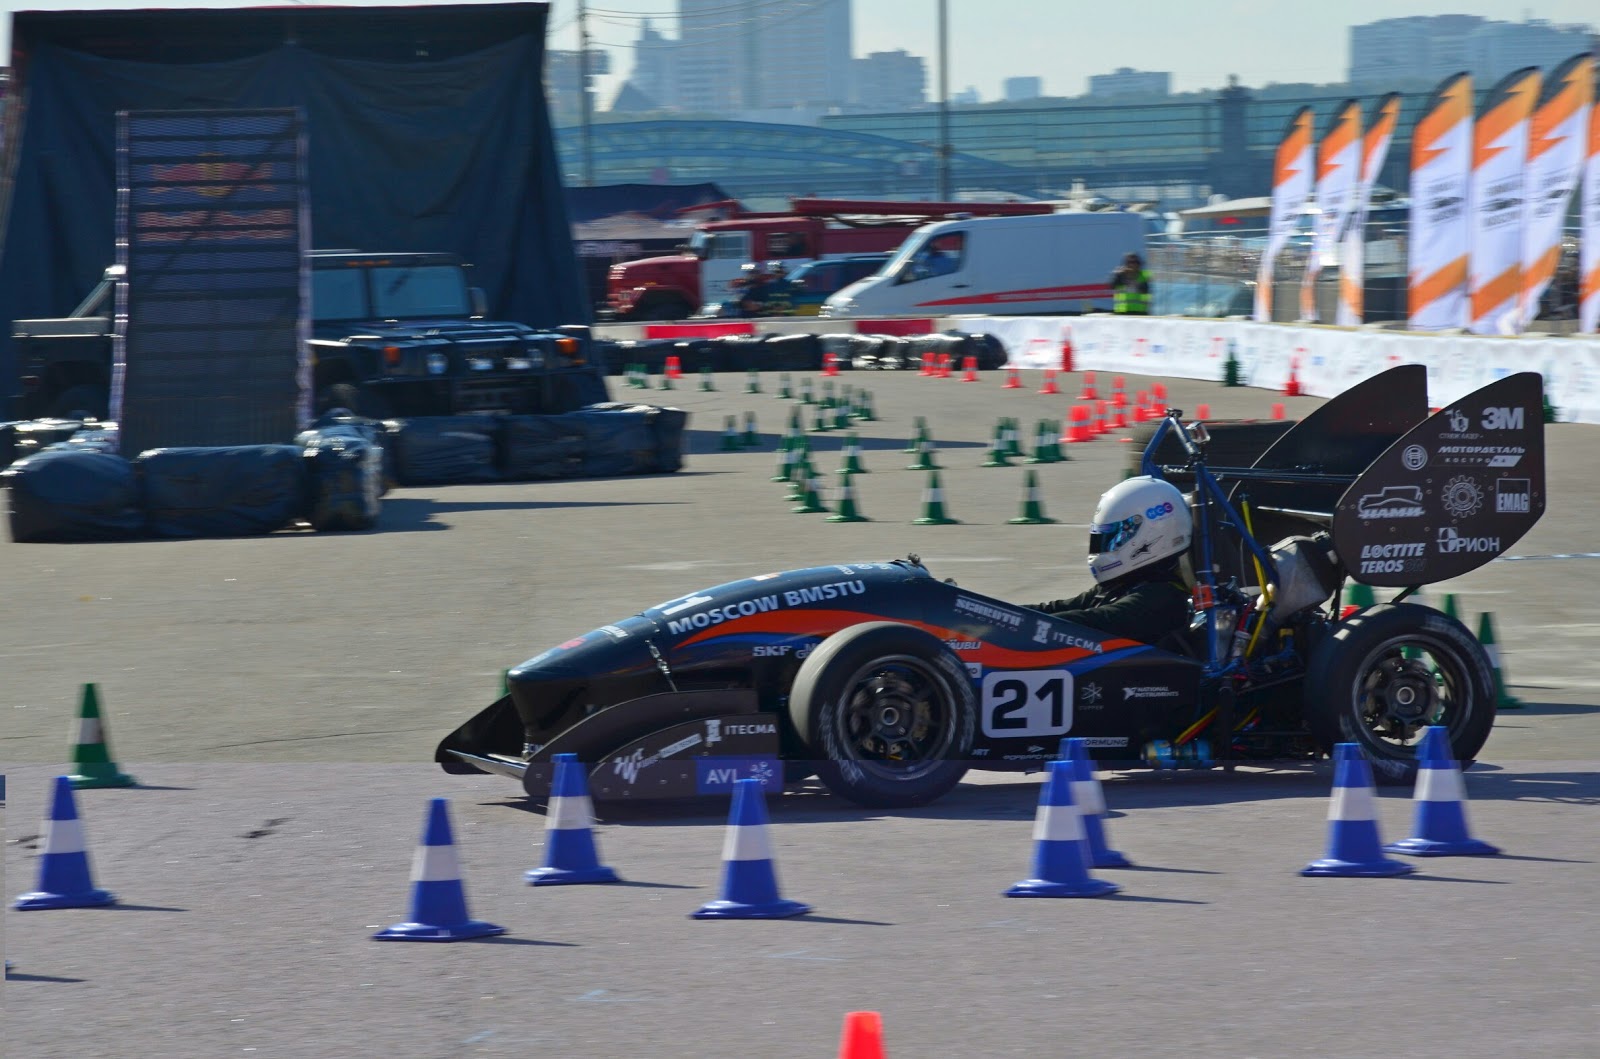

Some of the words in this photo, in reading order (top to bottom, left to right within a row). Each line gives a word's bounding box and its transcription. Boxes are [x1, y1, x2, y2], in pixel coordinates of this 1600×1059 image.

[1481, 407, 1524, 430] 3M
[1497, 493, 1529, 511] EMAG
[1360, 543, 1426, 559] LOCTITE
[667, 594, 779, 635] MOSCOW
[784, 579, 866, 607] BMSTU
[752, 646, 792, 657] SKF
[1053, 632, 1103, 654] ITECMA
[991, 678, 1064, 730] 21
[724, 724, 776, 735] ITECMA
[705, 768, 738, 784] AVL
